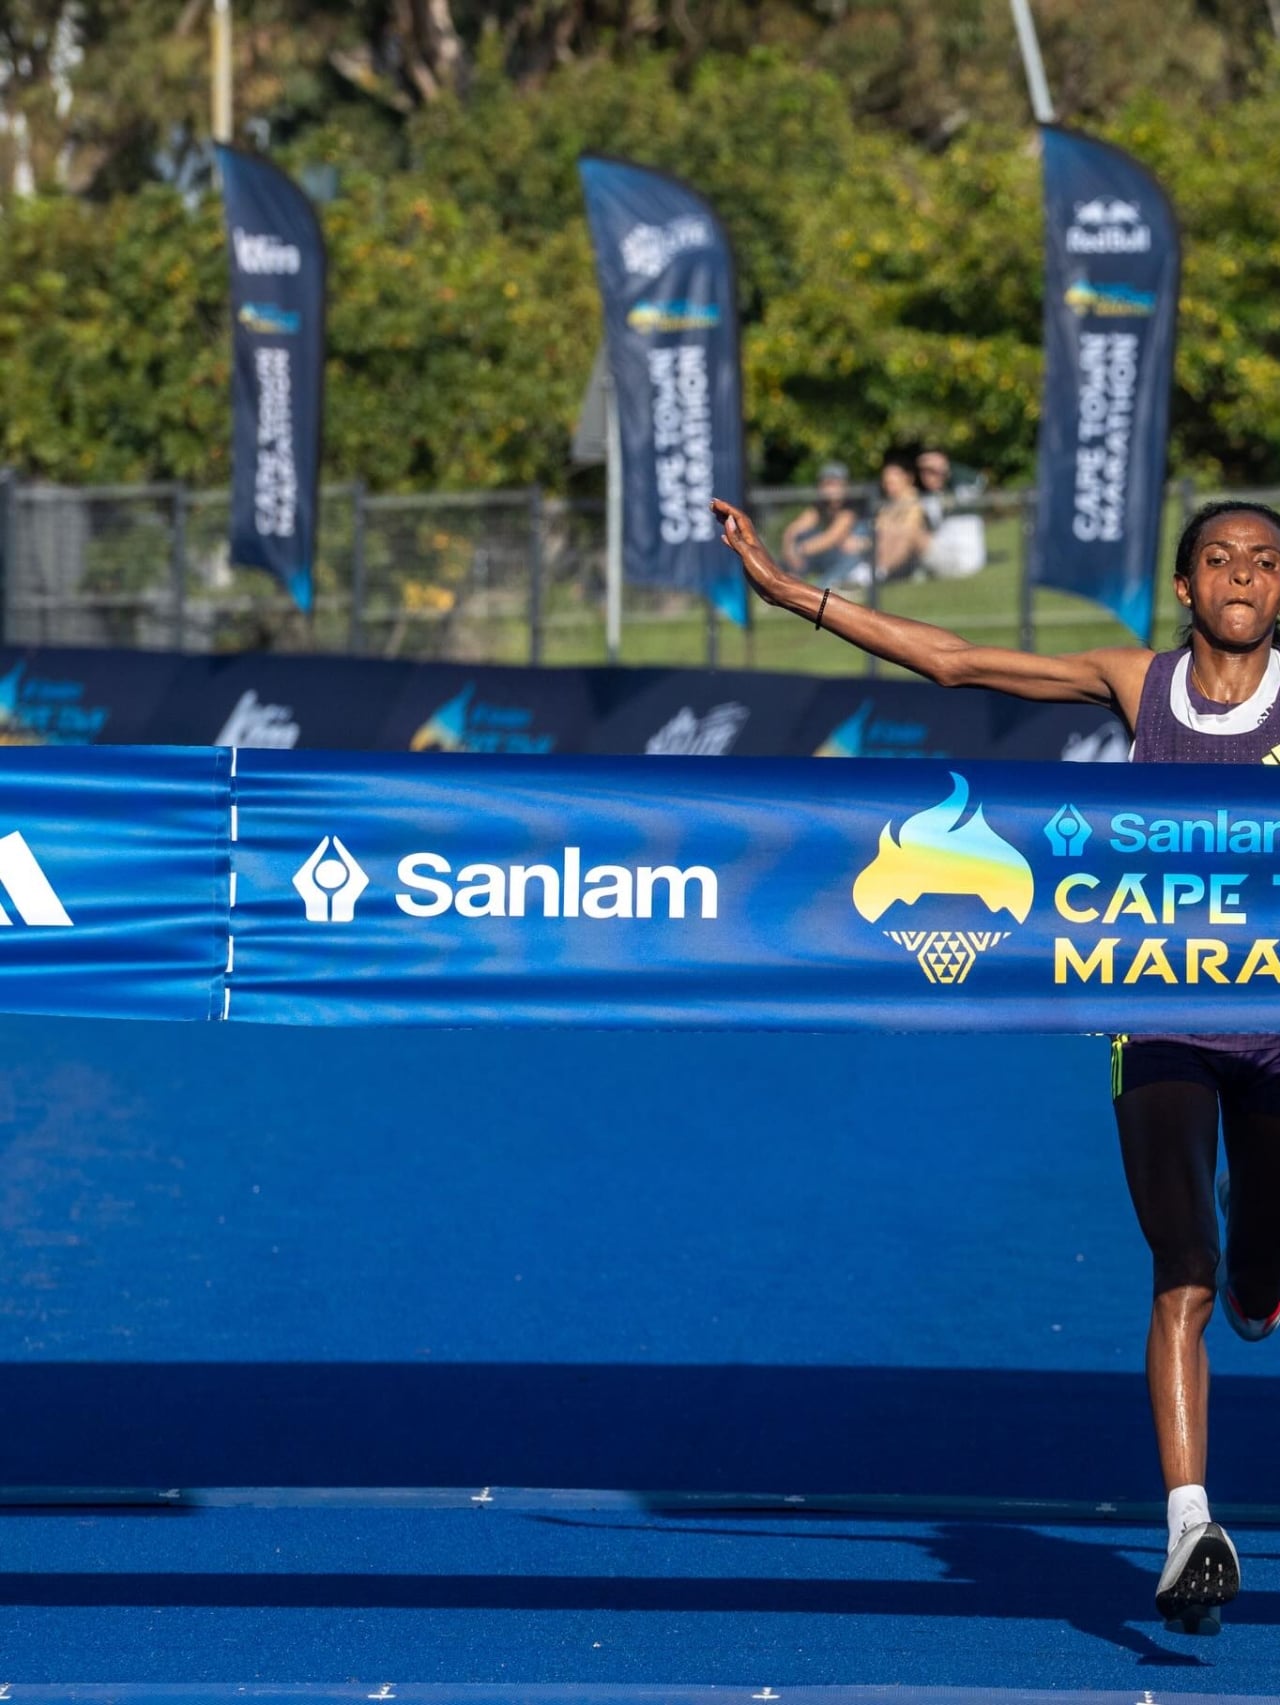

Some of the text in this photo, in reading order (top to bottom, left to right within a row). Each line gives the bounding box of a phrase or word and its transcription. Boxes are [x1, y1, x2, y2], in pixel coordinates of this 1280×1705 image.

[647, 347, 691, 545] CAPE TOWN
[677, 345, 715, 543] MARATHON
[1072, 331, 1108, 543] CAPE TOWN
[1100, 331, 1140, 543] MARATHON
[395, 846, 718, 918] Sanlam
[1054, 873, 1249, 924] CAPE
